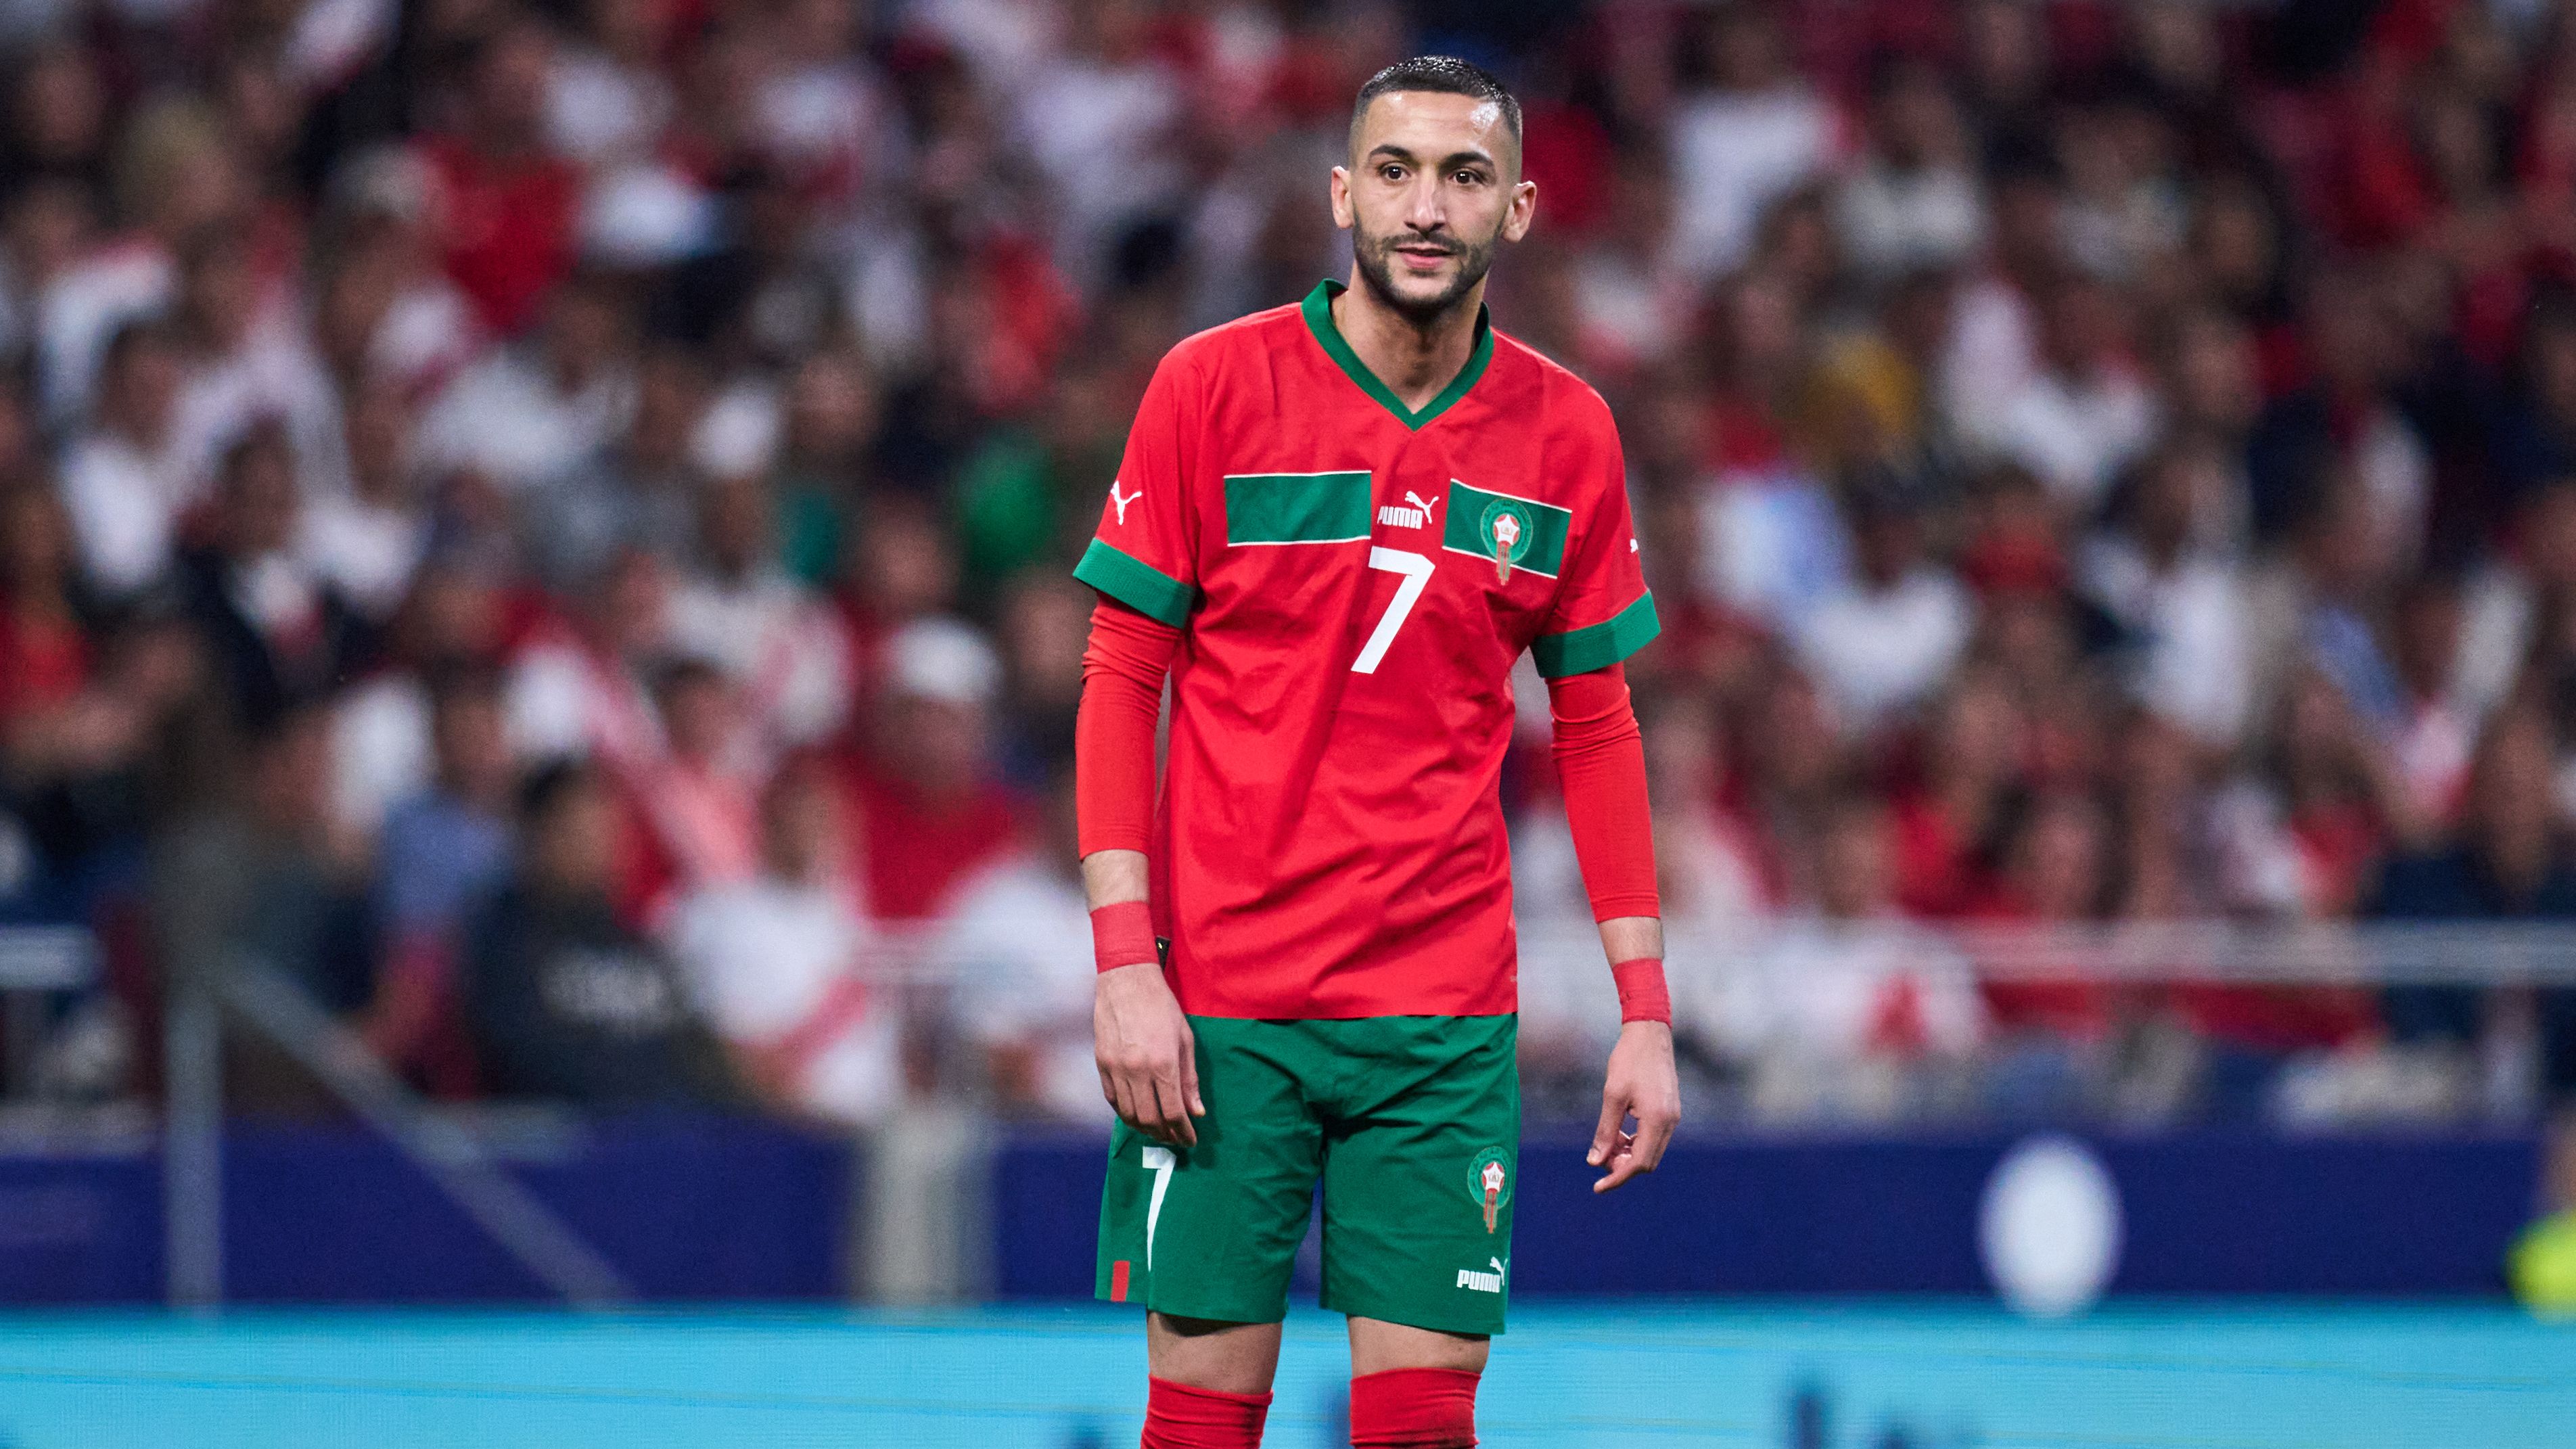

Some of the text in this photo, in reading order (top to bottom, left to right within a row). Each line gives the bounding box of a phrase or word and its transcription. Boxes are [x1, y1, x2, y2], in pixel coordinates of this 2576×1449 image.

[1377, 506, 1423, 530] PUMA
[1351, 546, 1435, 674] 7
[1142, 1146, 1177, 1272] 7
[1456, 1269, 1500, 1293] PUMA
